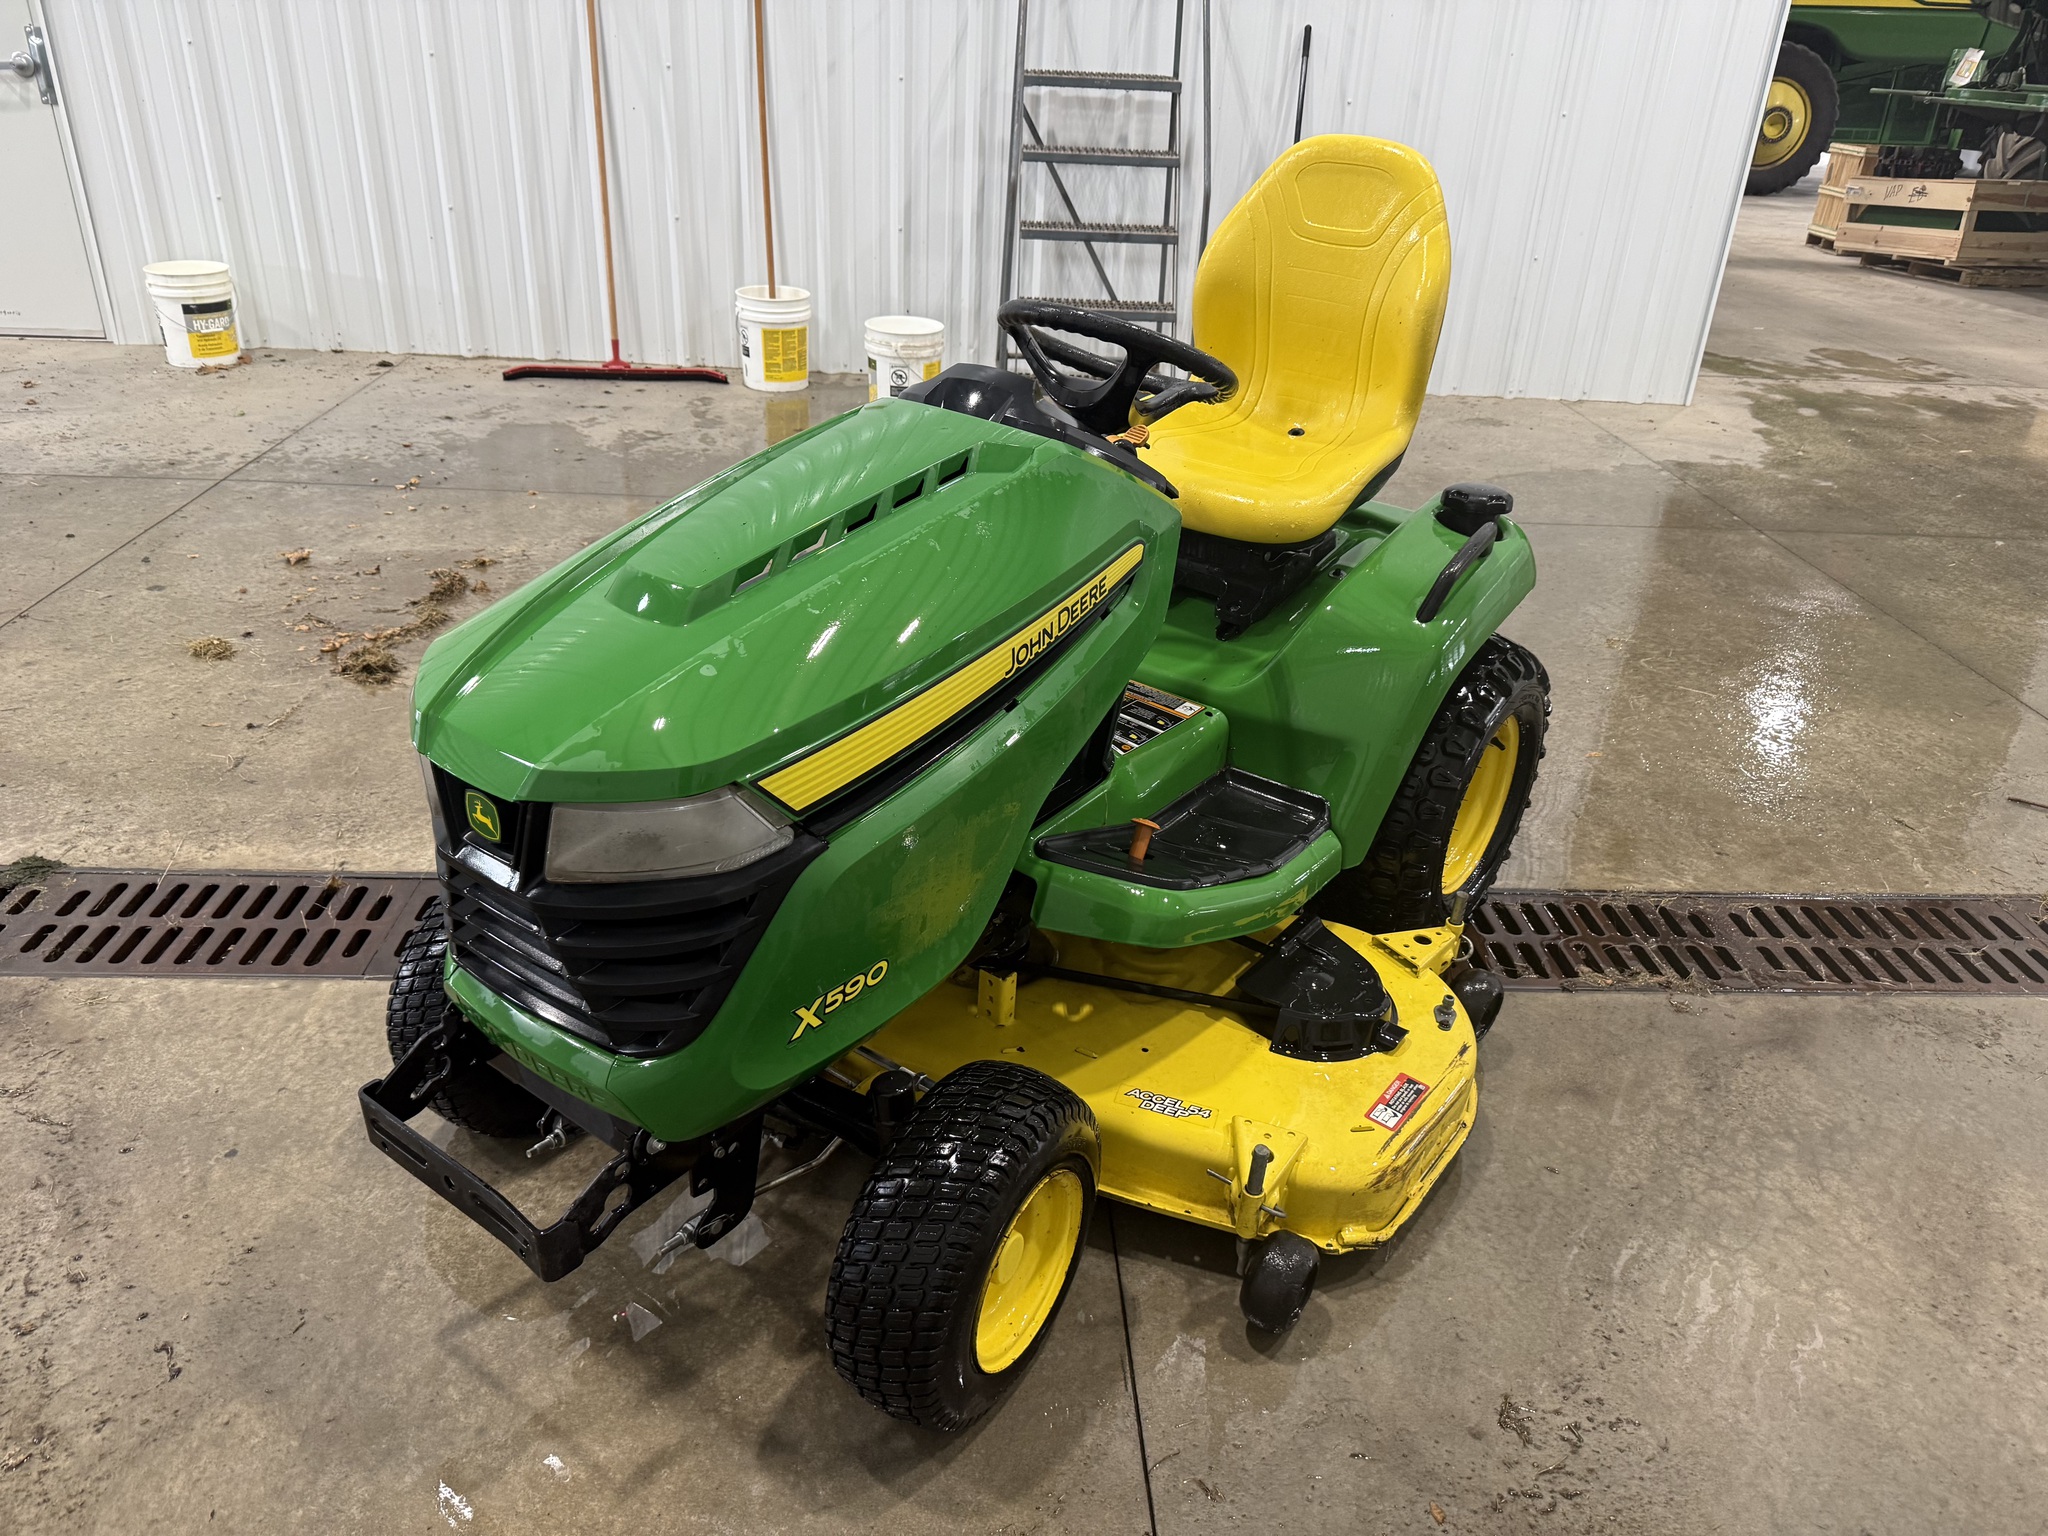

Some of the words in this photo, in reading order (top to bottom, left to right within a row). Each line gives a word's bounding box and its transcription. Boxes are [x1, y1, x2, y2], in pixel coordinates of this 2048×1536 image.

[193, 316, 230, 331] HY-GARD
[1005, 621, 1053, 677] JOHN
[1058, 575, 1107, 634] DEERE
[787, 959, 889, 1044] X590
[1124, 1088, 1187, 1110] ACCEL
[1187, 1105, 1212, 1119] 54
[1138, 1100, 1189, 1118] DEEP
